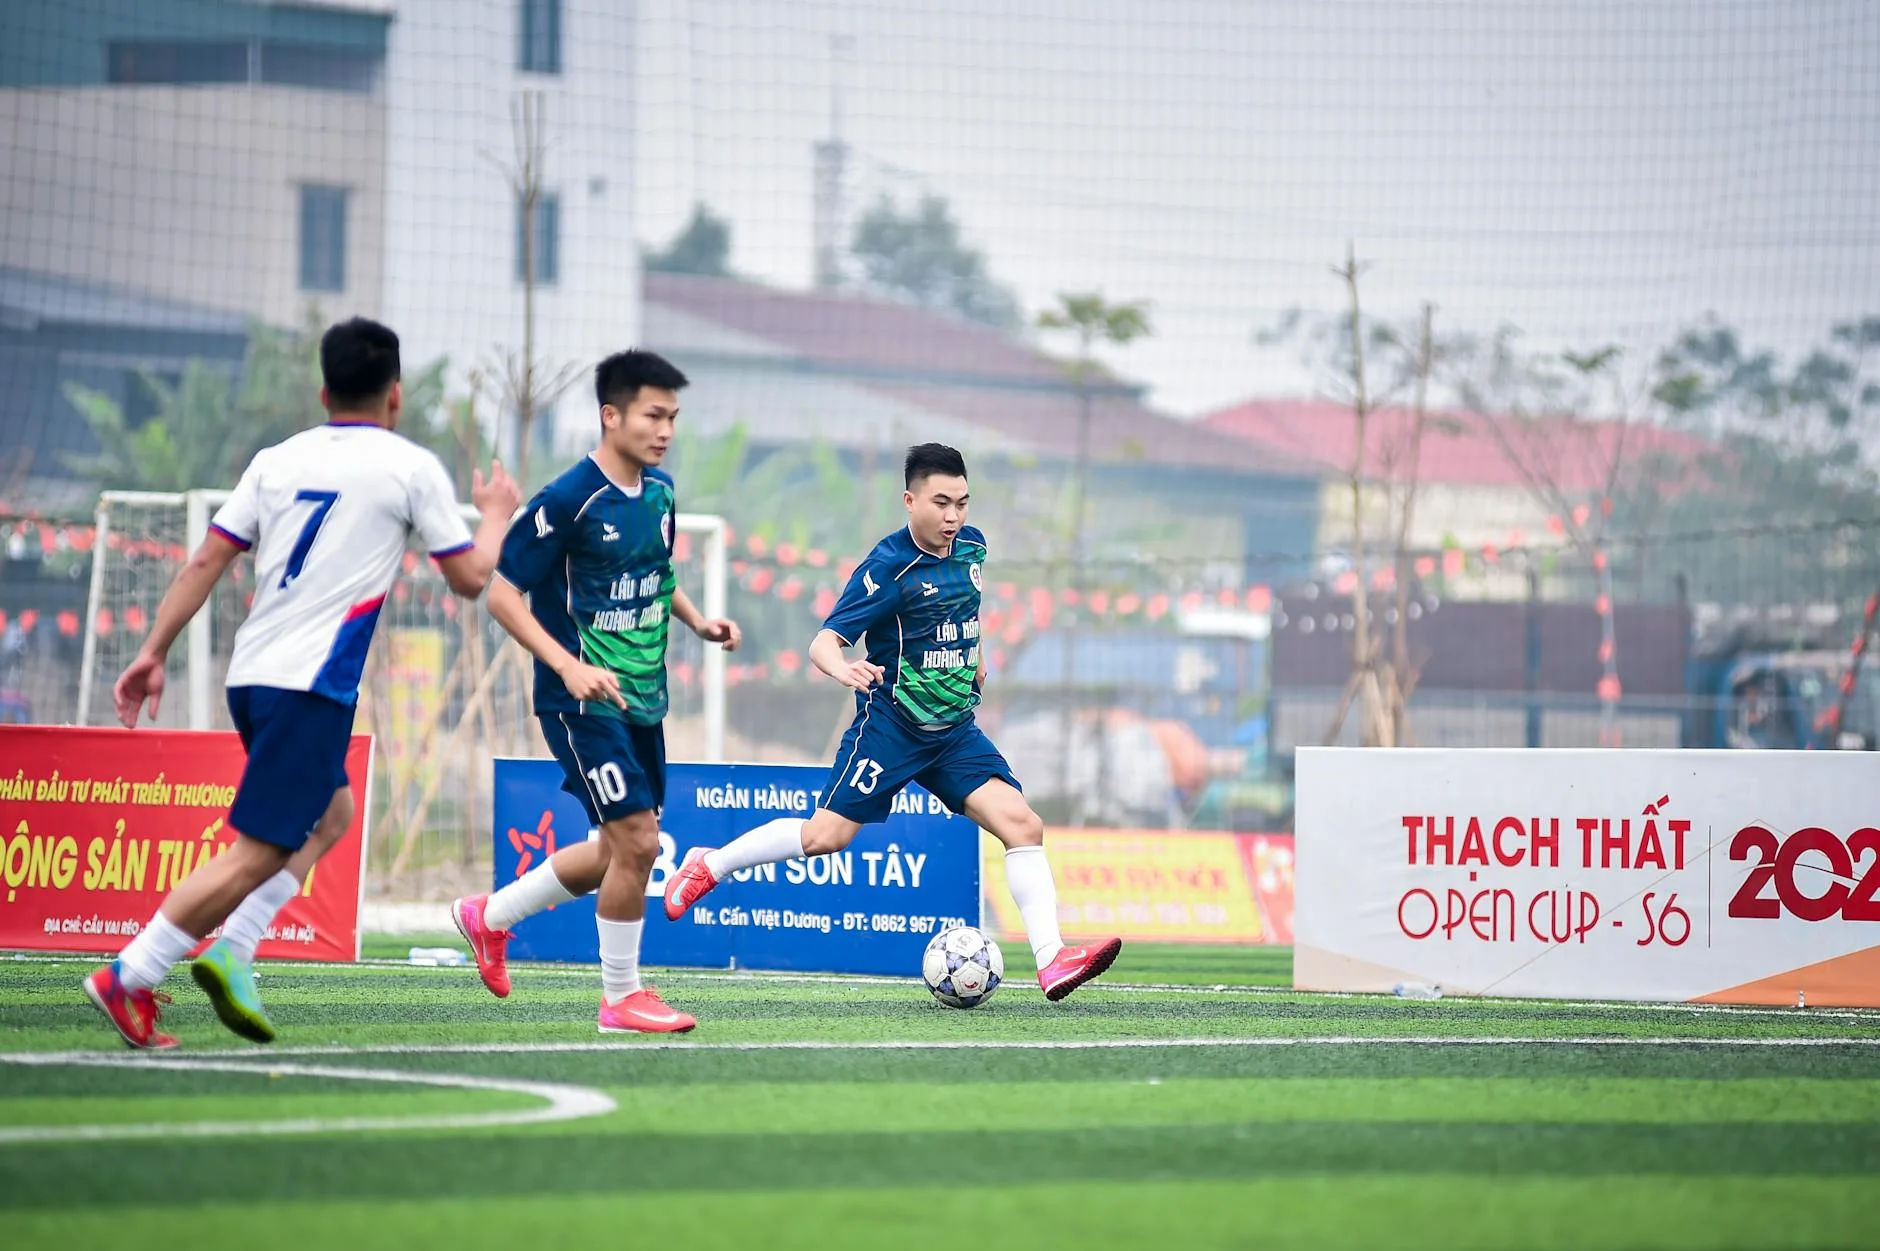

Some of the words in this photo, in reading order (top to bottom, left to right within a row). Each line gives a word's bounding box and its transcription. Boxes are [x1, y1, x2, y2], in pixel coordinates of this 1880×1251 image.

[295, 489, 341, 589] 7
[593, 607, 636, 632] HOÀNG
[936, 618, 958, 641] LẨU
[923, 647, 965, 668] HOÀNG
[91, 776, 130, 804] PHÁT
[174, 781, 236, 808] THƯƠNG
[587, 761, 627, 805] 10
[850, 758, 884, 794] 13
[696, 783, 749, 809] NGÂN
[754, 784, 807, 811] HÀNG
[1402, 816, 1559, 881] THẠCH
[1576, 794, 1691, 870] THẤT
[0, 819, 78, 903] ỘNG
[83, 818, 150, 891] SẢN
[155, 817, 234, 892] TUẤ
[862, 843, 926, 888] TÂY
[693, 907, 716, 925] Mr.
[719, 906, 748, 926] Cấn
[751, 908, 780, 930] Việt
[783, 912, 831, 934] Dương
[843, 913, 869, 931] ĐT:
[871, 915, 906, 932] 0862
[909, 916, 935, 933] 967
[1528, 891, 1600, 944] CUP
[1637, 892, 1691, 946] S6
